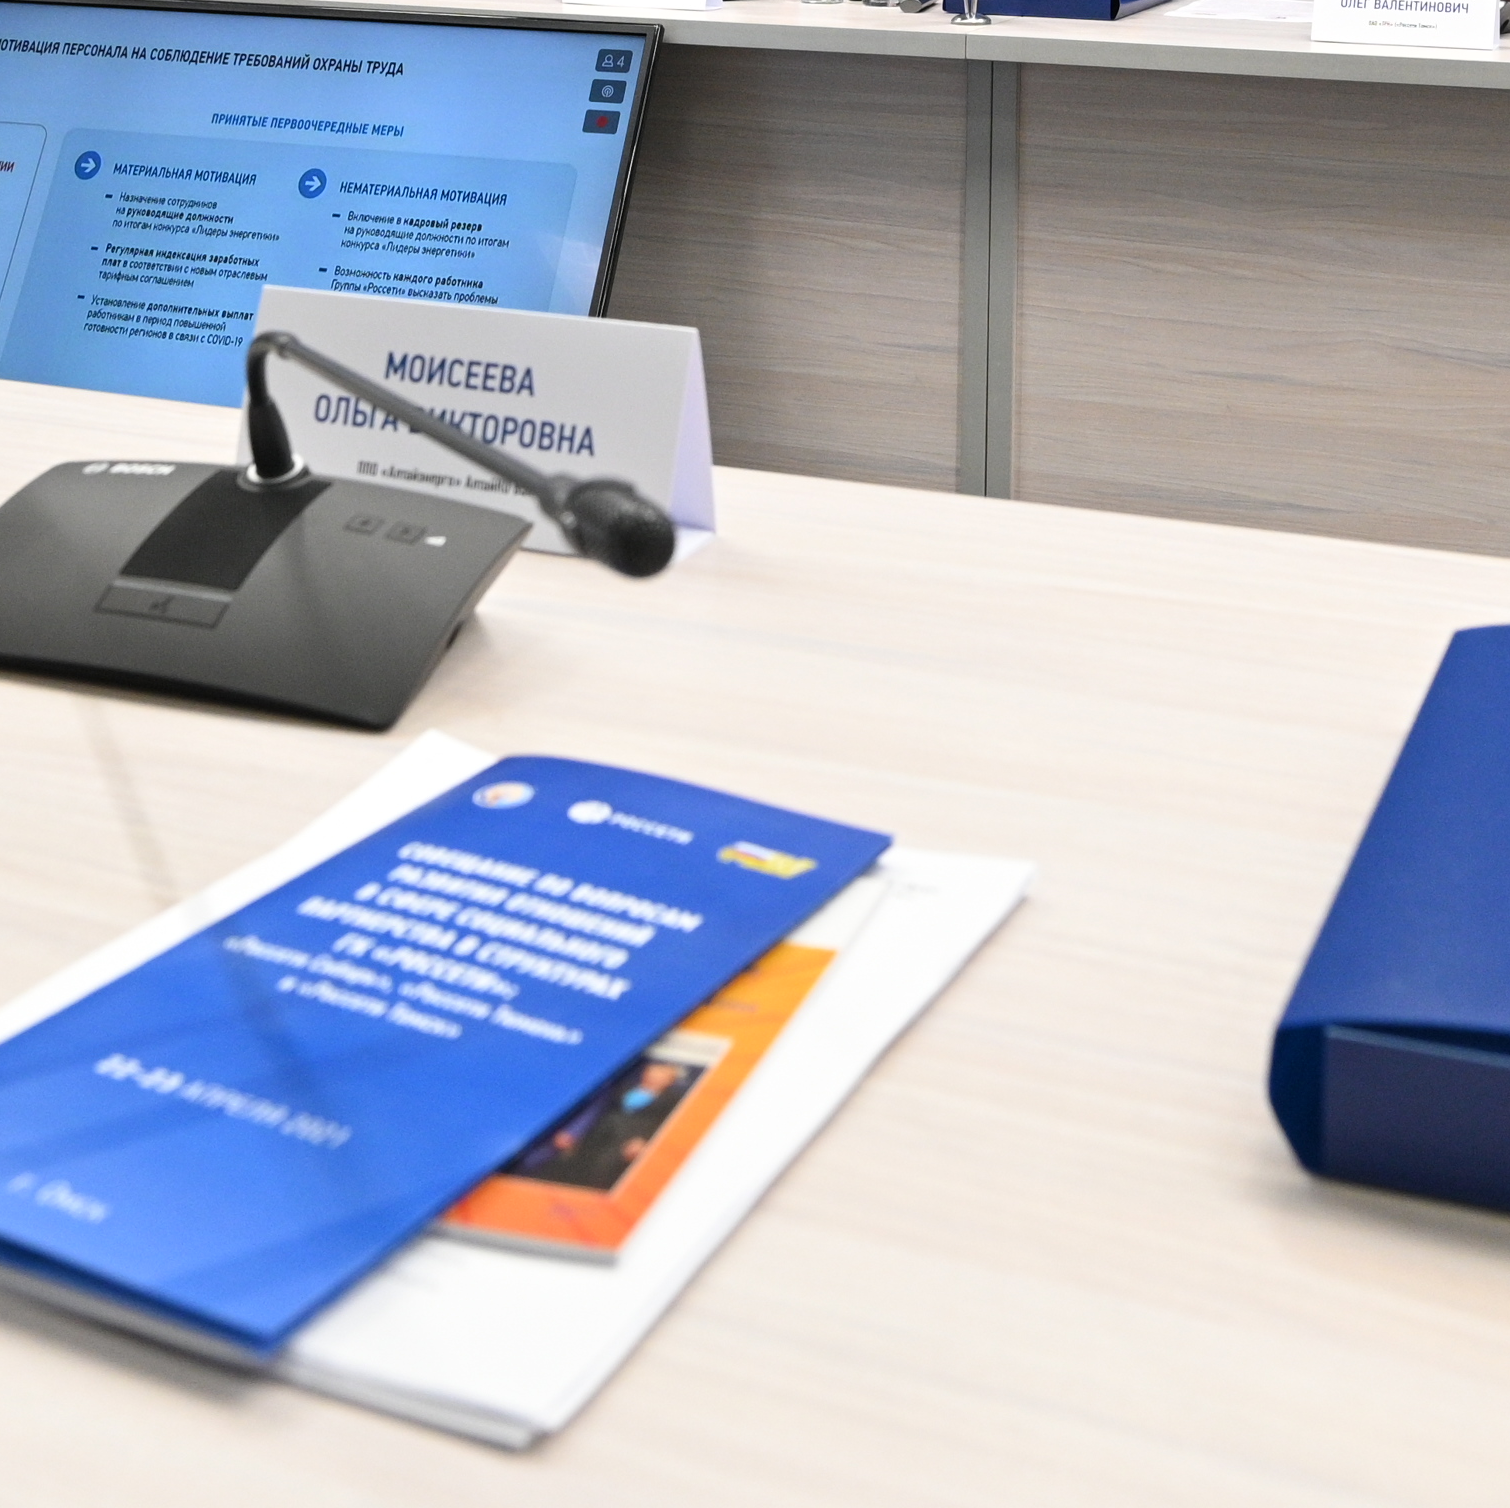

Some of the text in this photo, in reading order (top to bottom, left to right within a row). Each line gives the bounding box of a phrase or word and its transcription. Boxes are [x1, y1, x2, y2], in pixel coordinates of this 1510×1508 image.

[62, 42, 128, 58] ПЕРСОНАЛА
[131, 46, 147, 60] НА
[149, 48, 231, 65] СОБЛЮДЕНИЕ
[233, 52, 310, 70] ТРЕБОВАНИЙ
[312, 57, 364, 73] ОХРАНЫ
[366, 60, 405, 77] ТРУДА
[616, 55, 625, 68] 4
[211, 112, 405, 138] ПРИНЯТЫЕ ПЕРВООЧЕРЕДНЫЕ МЕРЫ
[113, 163, 257, 187] МАТЕРИАЛЬНАЯ МОТИВАЦИЯ
[119, 191, 218, 210] Назначение сотрудников
[339, 181, 508, 207] НЕМАТЕРИАЛЬНАЯ МОТИВАЦИЯ
[115, 206, 234, 224] на руководящие должности
[347, 211, 395, 225] Включение
[403, 217, 449, 230] кадровый
[450, 222, 483, 233] резерв
[112, 218, 280, 242] по итогам конкурса «Лидеры энергетики»
[344, 225, 510, 248] на руководящие должности по итогам
[105, 243, 260, 267] Регулярная индексация заработных
[340, 239, 475, 259] конкурса «Лидеры энергетики»
[99, 269, 195, 288] тарифным соглашением
[101, 257, 122, 268] плат
[129, 259, 182, 273] соответствии
[190, 267, 218, 276] новым
[218, 269, 268, 281] отраслевым
[333, 265, 484, 289] Возможность каждого работника
[331, 279, 499, 305] Группы «Россети» высказать проблемы
[90, 294, 254, 321] Установление дополнительных выплат
[86, 309, 135, 323] работникам
[142, 315, 173, 328] период
[173, 318, 227, 332] повышенной
[84, 322, 128, 335] готовности
[128, 326, 167, 340] регионов
[175, 332, 199, 342] связи
[206, 334, 244, 347] COVID-19
[384, 351, 536, 397] МОИСЕЕВА
